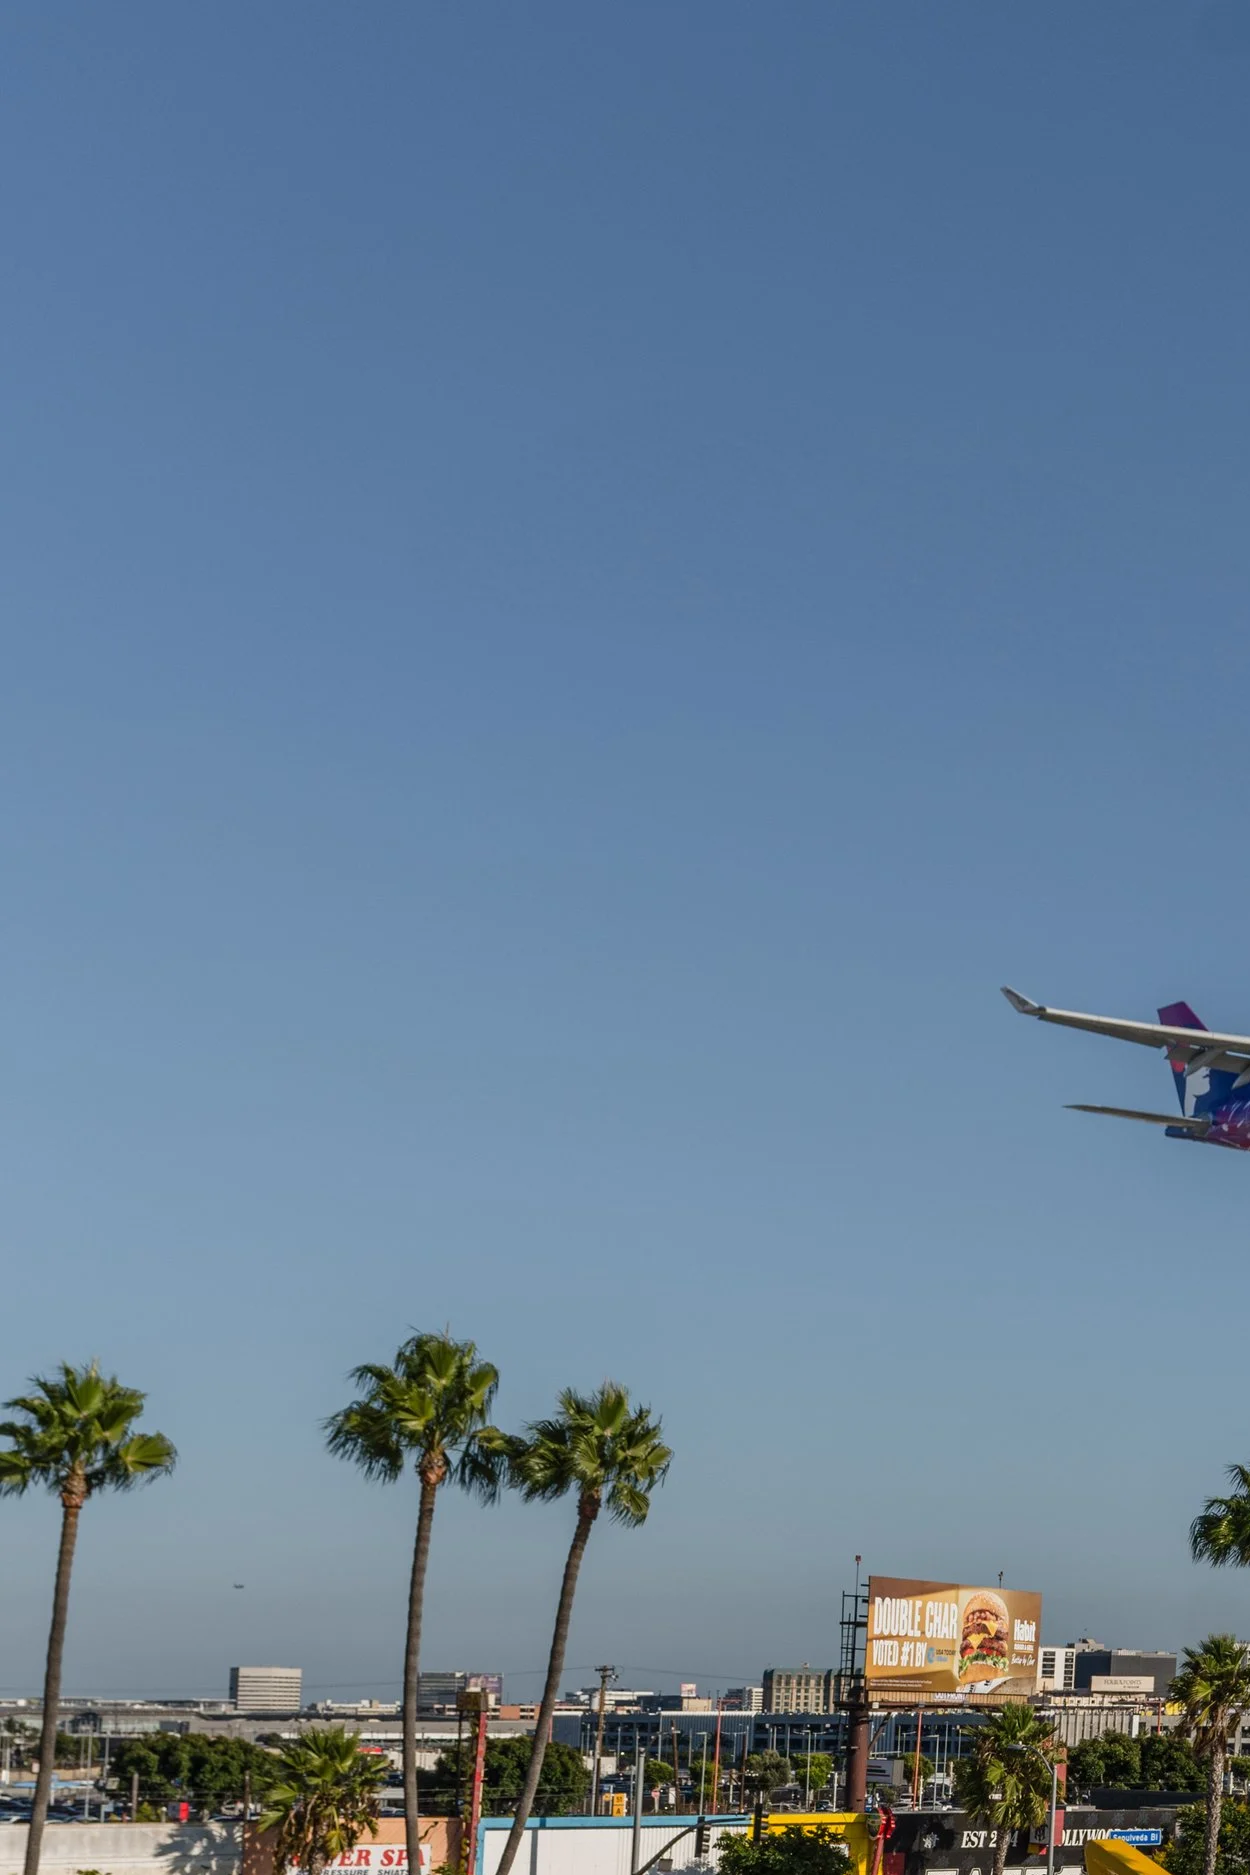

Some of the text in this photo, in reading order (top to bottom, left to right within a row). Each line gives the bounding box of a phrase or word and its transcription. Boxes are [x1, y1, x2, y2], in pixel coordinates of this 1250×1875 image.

[873, 1597, 958, 1639] DOUBLE CHAR
[1014, 1619, 1036, 1642] Habit
[872, 1640, 927, 1667] VOTED #1 BY
[961, 1831, 1019, 1848] EST 24
